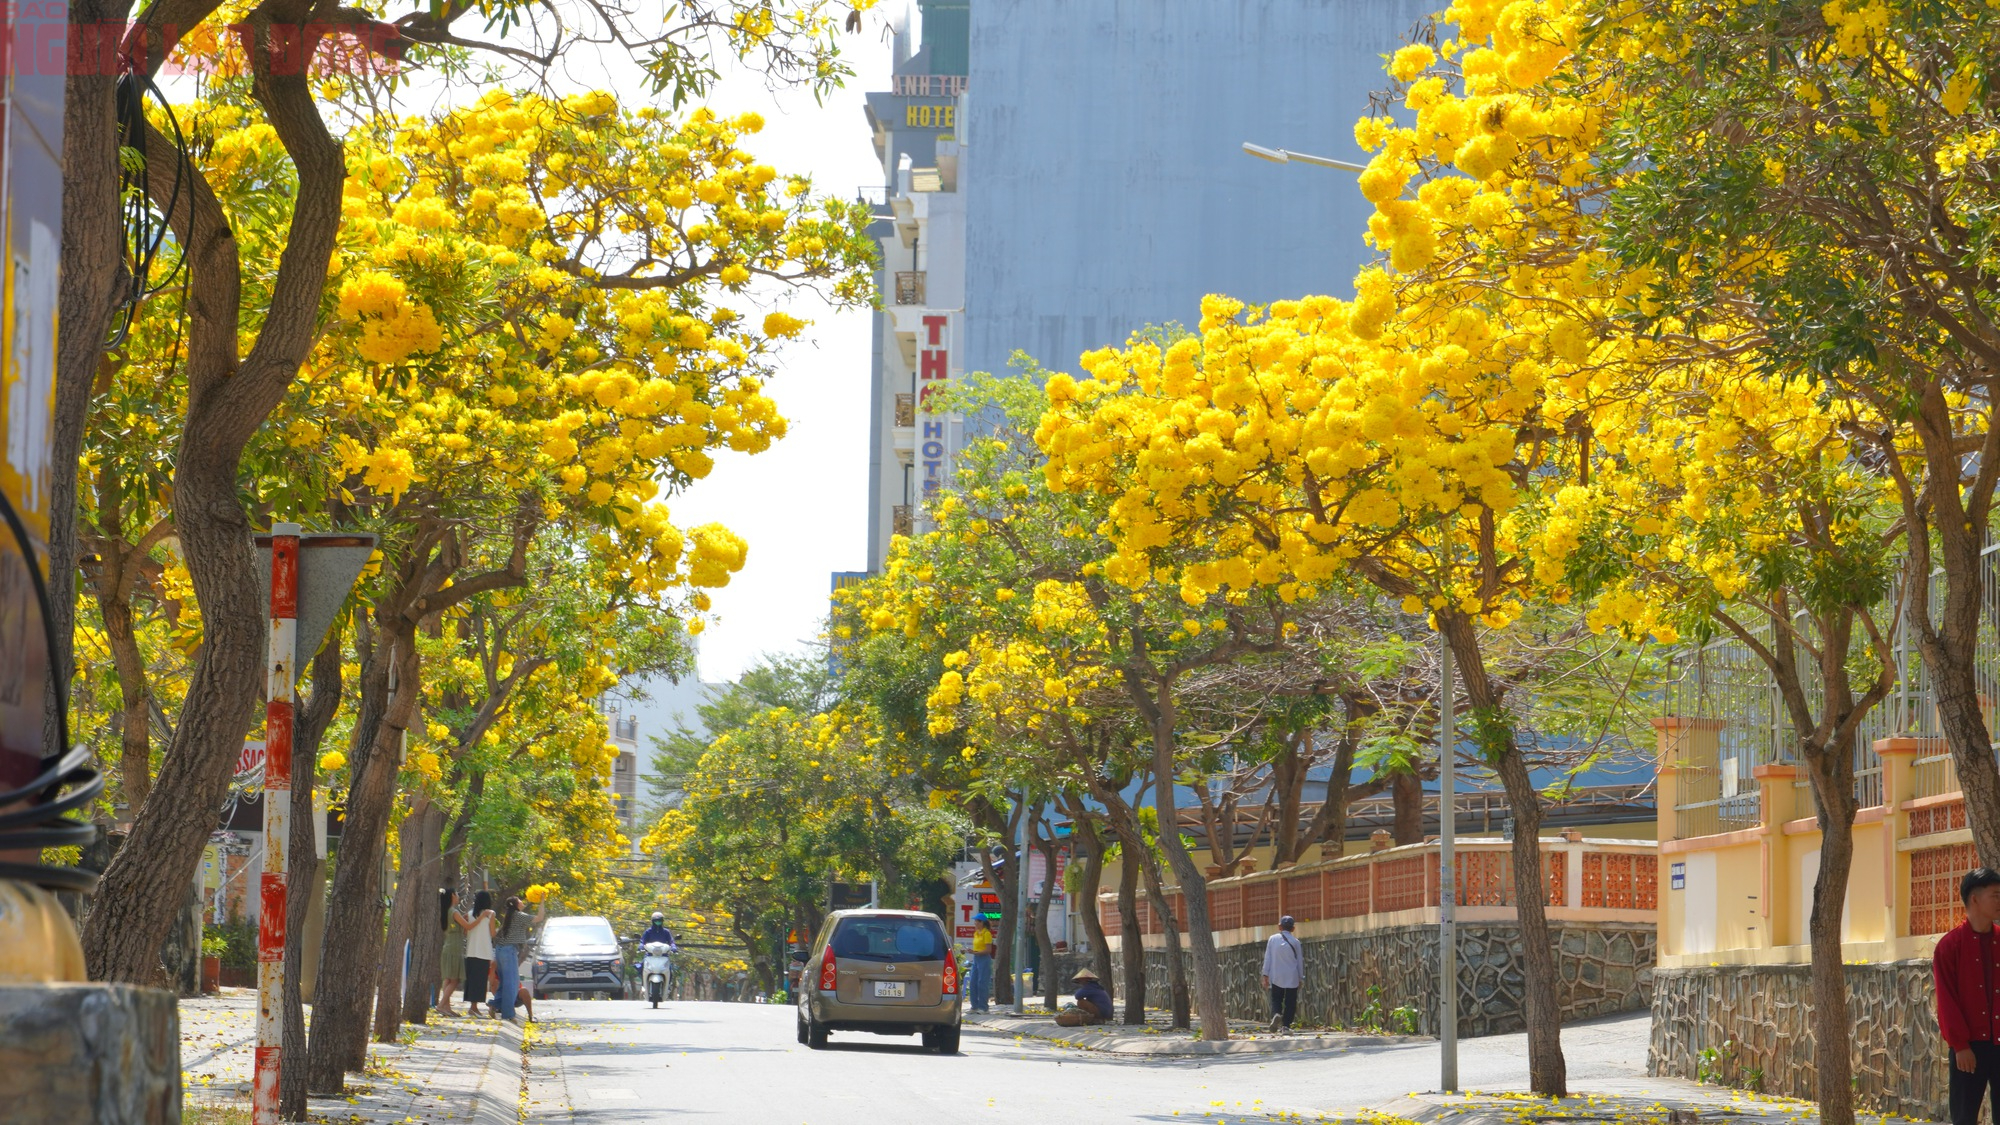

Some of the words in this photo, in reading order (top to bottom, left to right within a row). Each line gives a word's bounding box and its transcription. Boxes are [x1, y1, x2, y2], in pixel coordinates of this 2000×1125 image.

[892, 75, 930, 95] ANH
[906, 105, 954, 127] HOTE
[921, 421, 944, 498] HOTE
